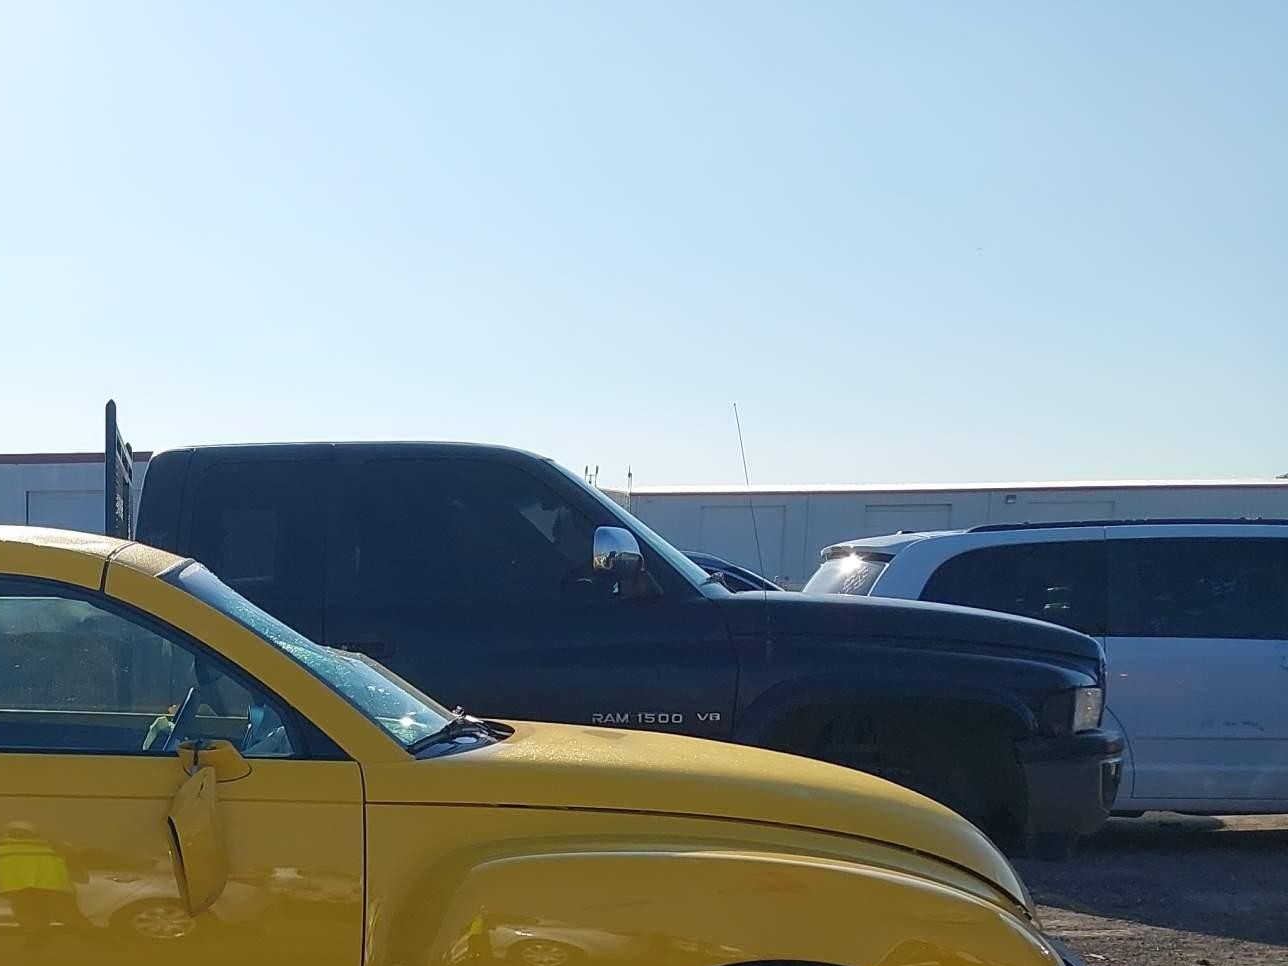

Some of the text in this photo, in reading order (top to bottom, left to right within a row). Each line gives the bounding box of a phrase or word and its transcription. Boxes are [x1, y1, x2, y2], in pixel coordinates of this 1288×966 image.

[591, 712, 721, 724] RAM 1500 V8
